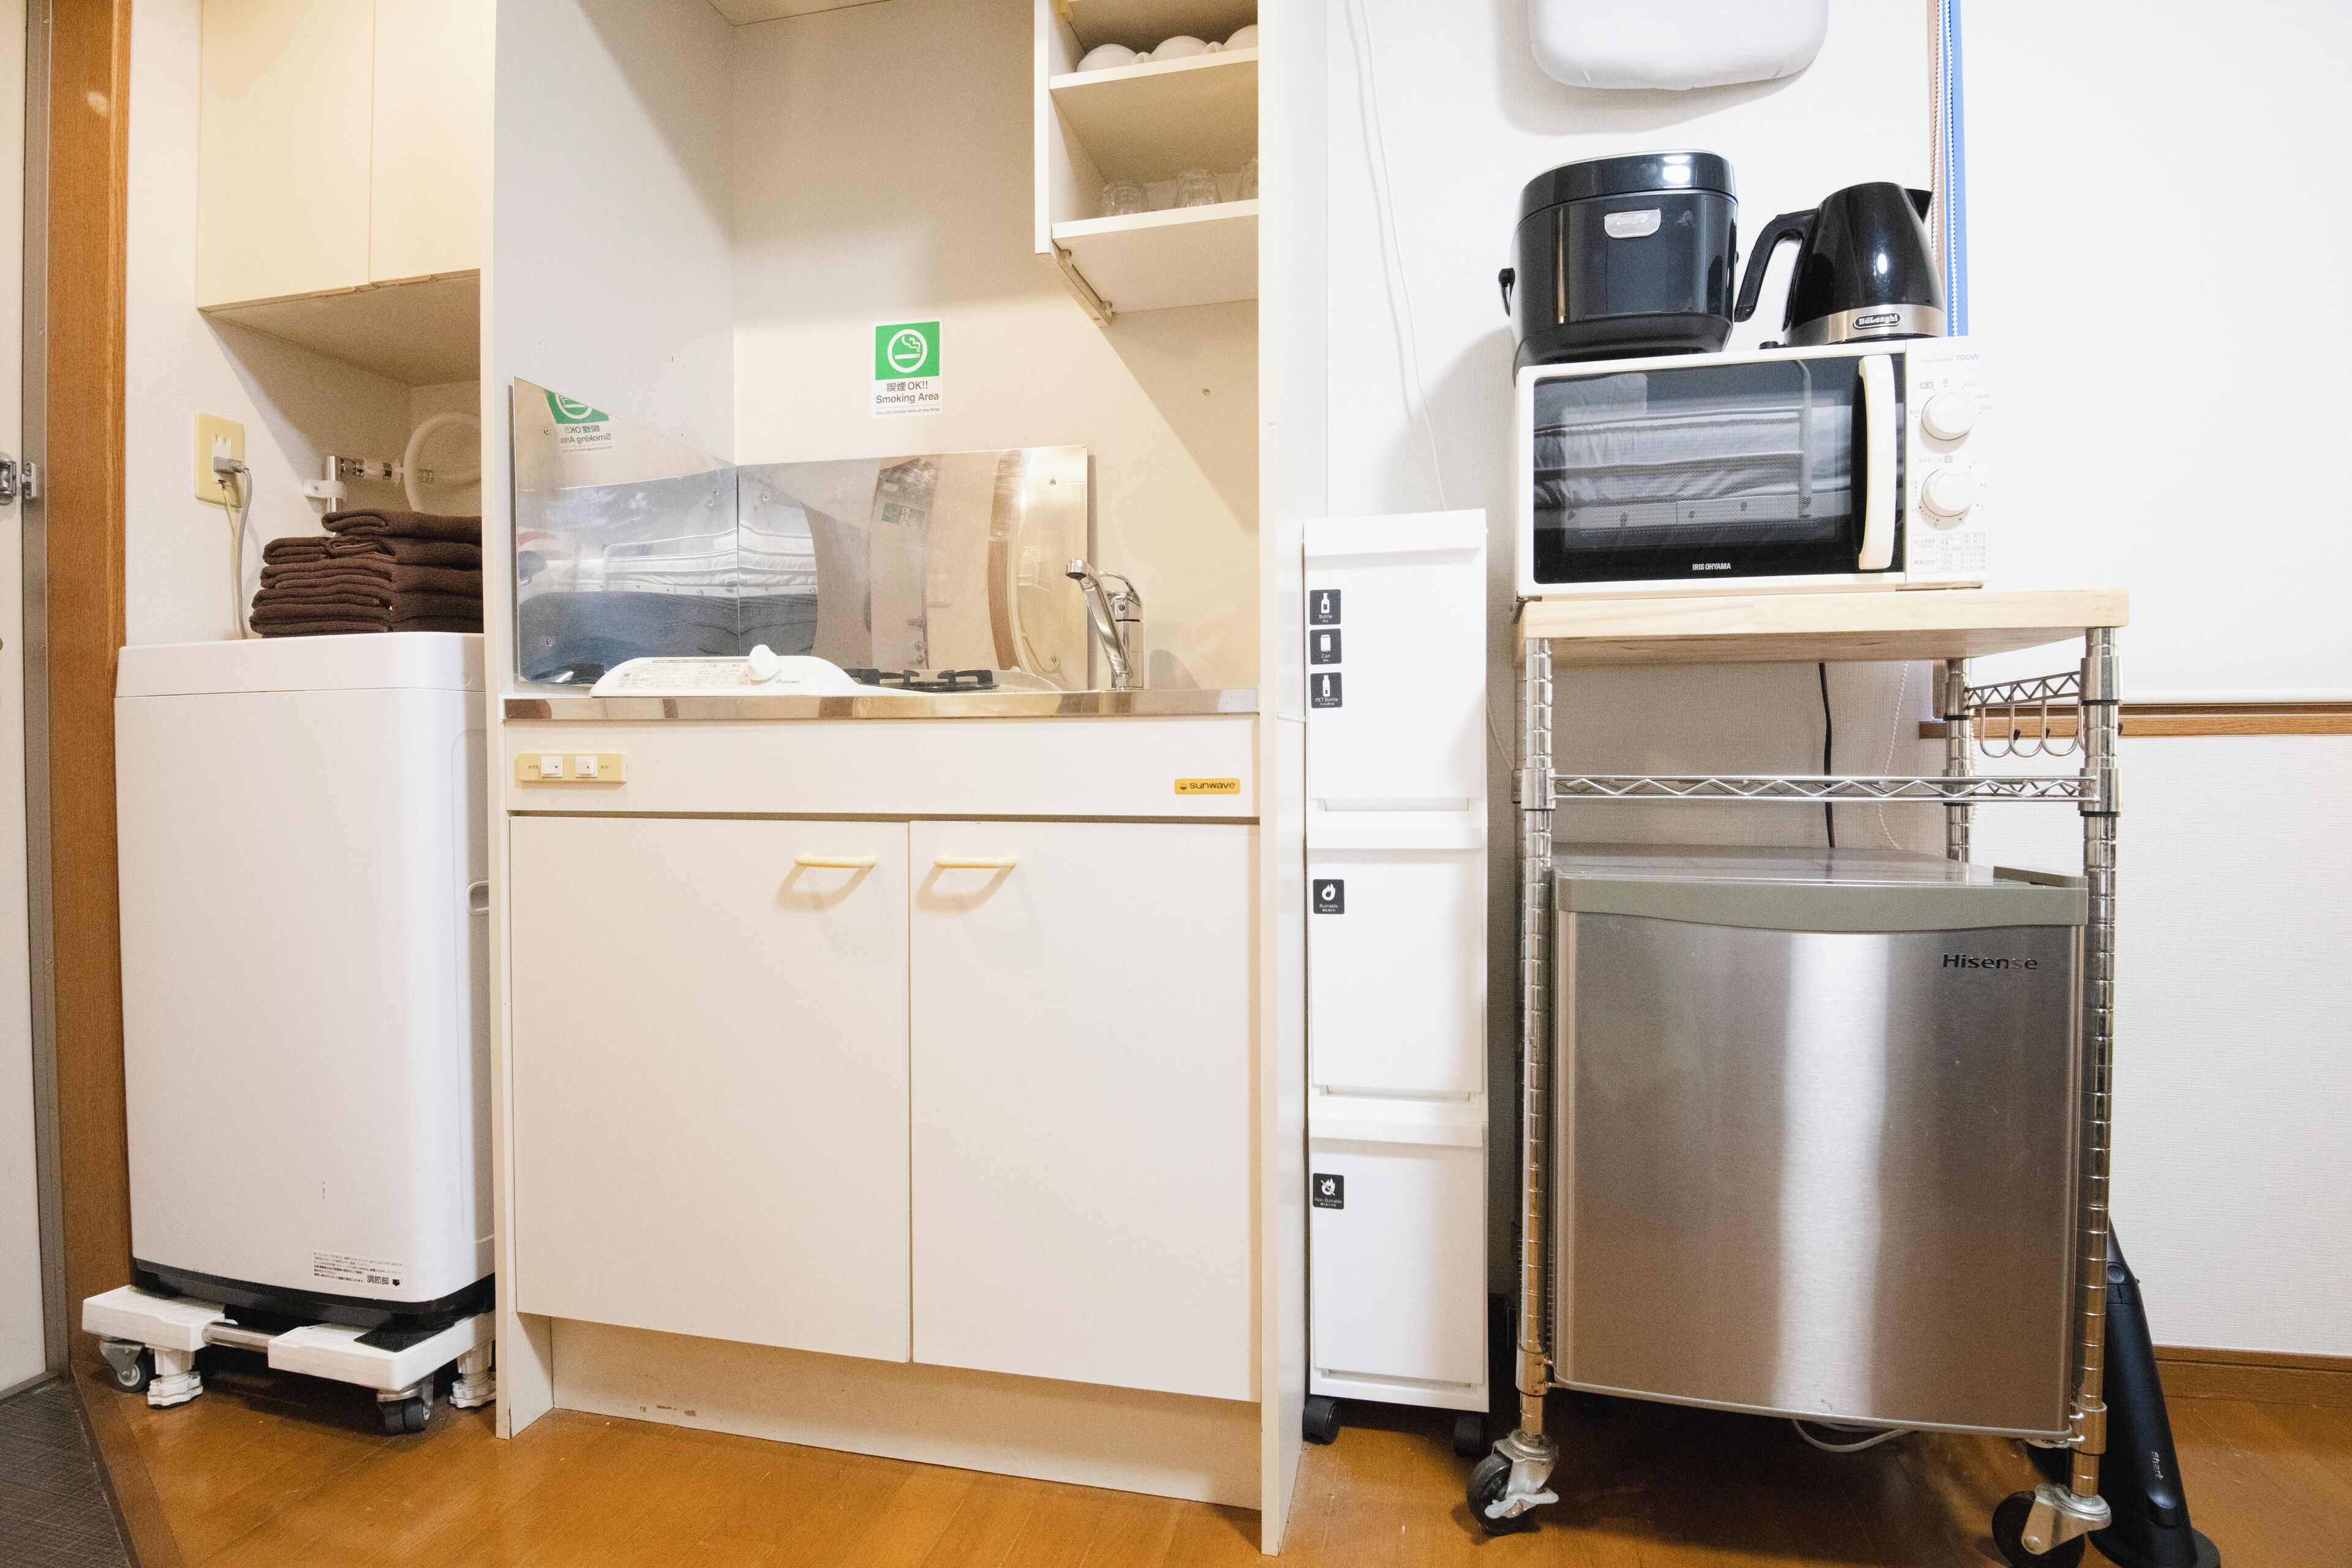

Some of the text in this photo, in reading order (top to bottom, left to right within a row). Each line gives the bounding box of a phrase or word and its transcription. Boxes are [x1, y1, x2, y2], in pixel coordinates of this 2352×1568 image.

[876, 393, 939, 404] Smoking Area
[1942, 954, 2038, 970] Hisense
[367, 1275, 390, 1285] 調節脚
[2151, 1451, 2164, 1480] Shark
